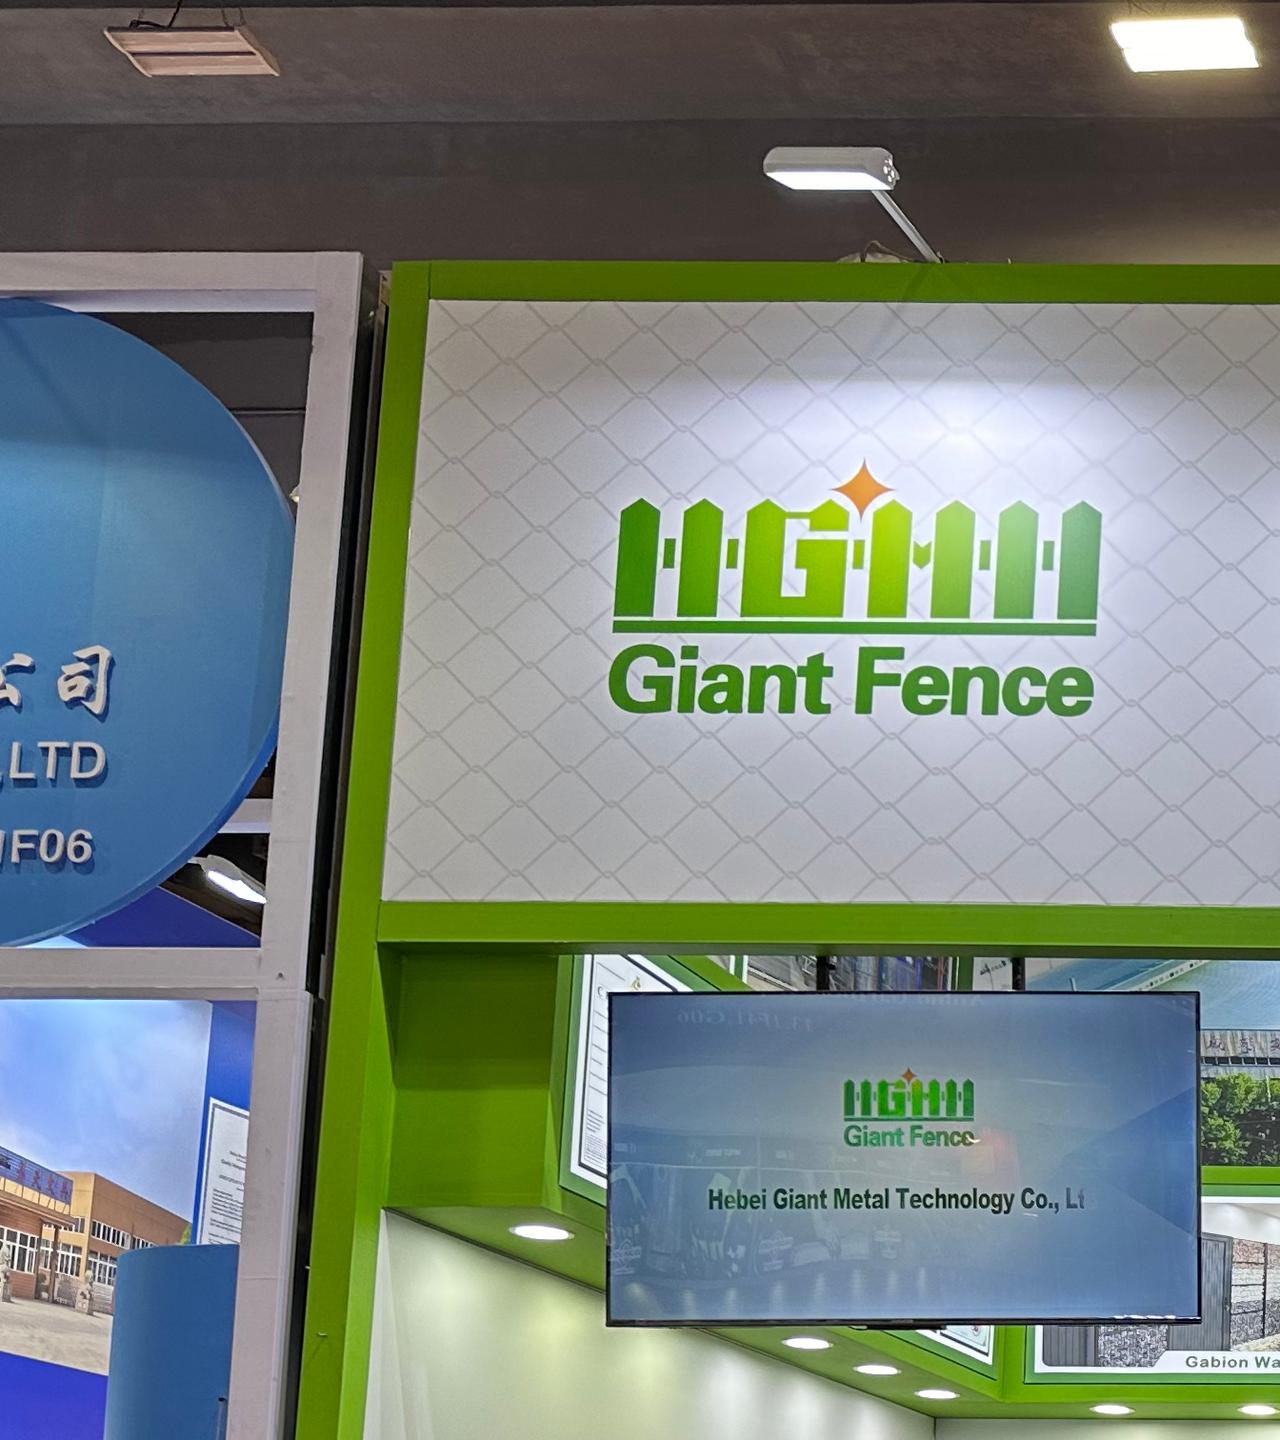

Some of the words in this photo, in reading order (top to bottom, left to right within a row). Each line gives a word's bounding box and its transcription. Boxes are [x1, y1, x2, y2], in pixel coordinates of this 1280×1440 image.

[608, 643, 834, 715] Giant
[855, 646, 1095, 717] Fence
[843, 1125, 904, 1148] Giant
[909, 1125, 975, 1148] Fence
[708, 1188, 767, 1211] Hebei
[773, 1187, 828, 1210] Giant
[833, 1187, 890, 1210] Metal
[895, 1187, 1015, 1215] Technology
[1020, 1187, 1060, 1215] Co.,
[1185, 1355, 1249, 1369] Gabion
